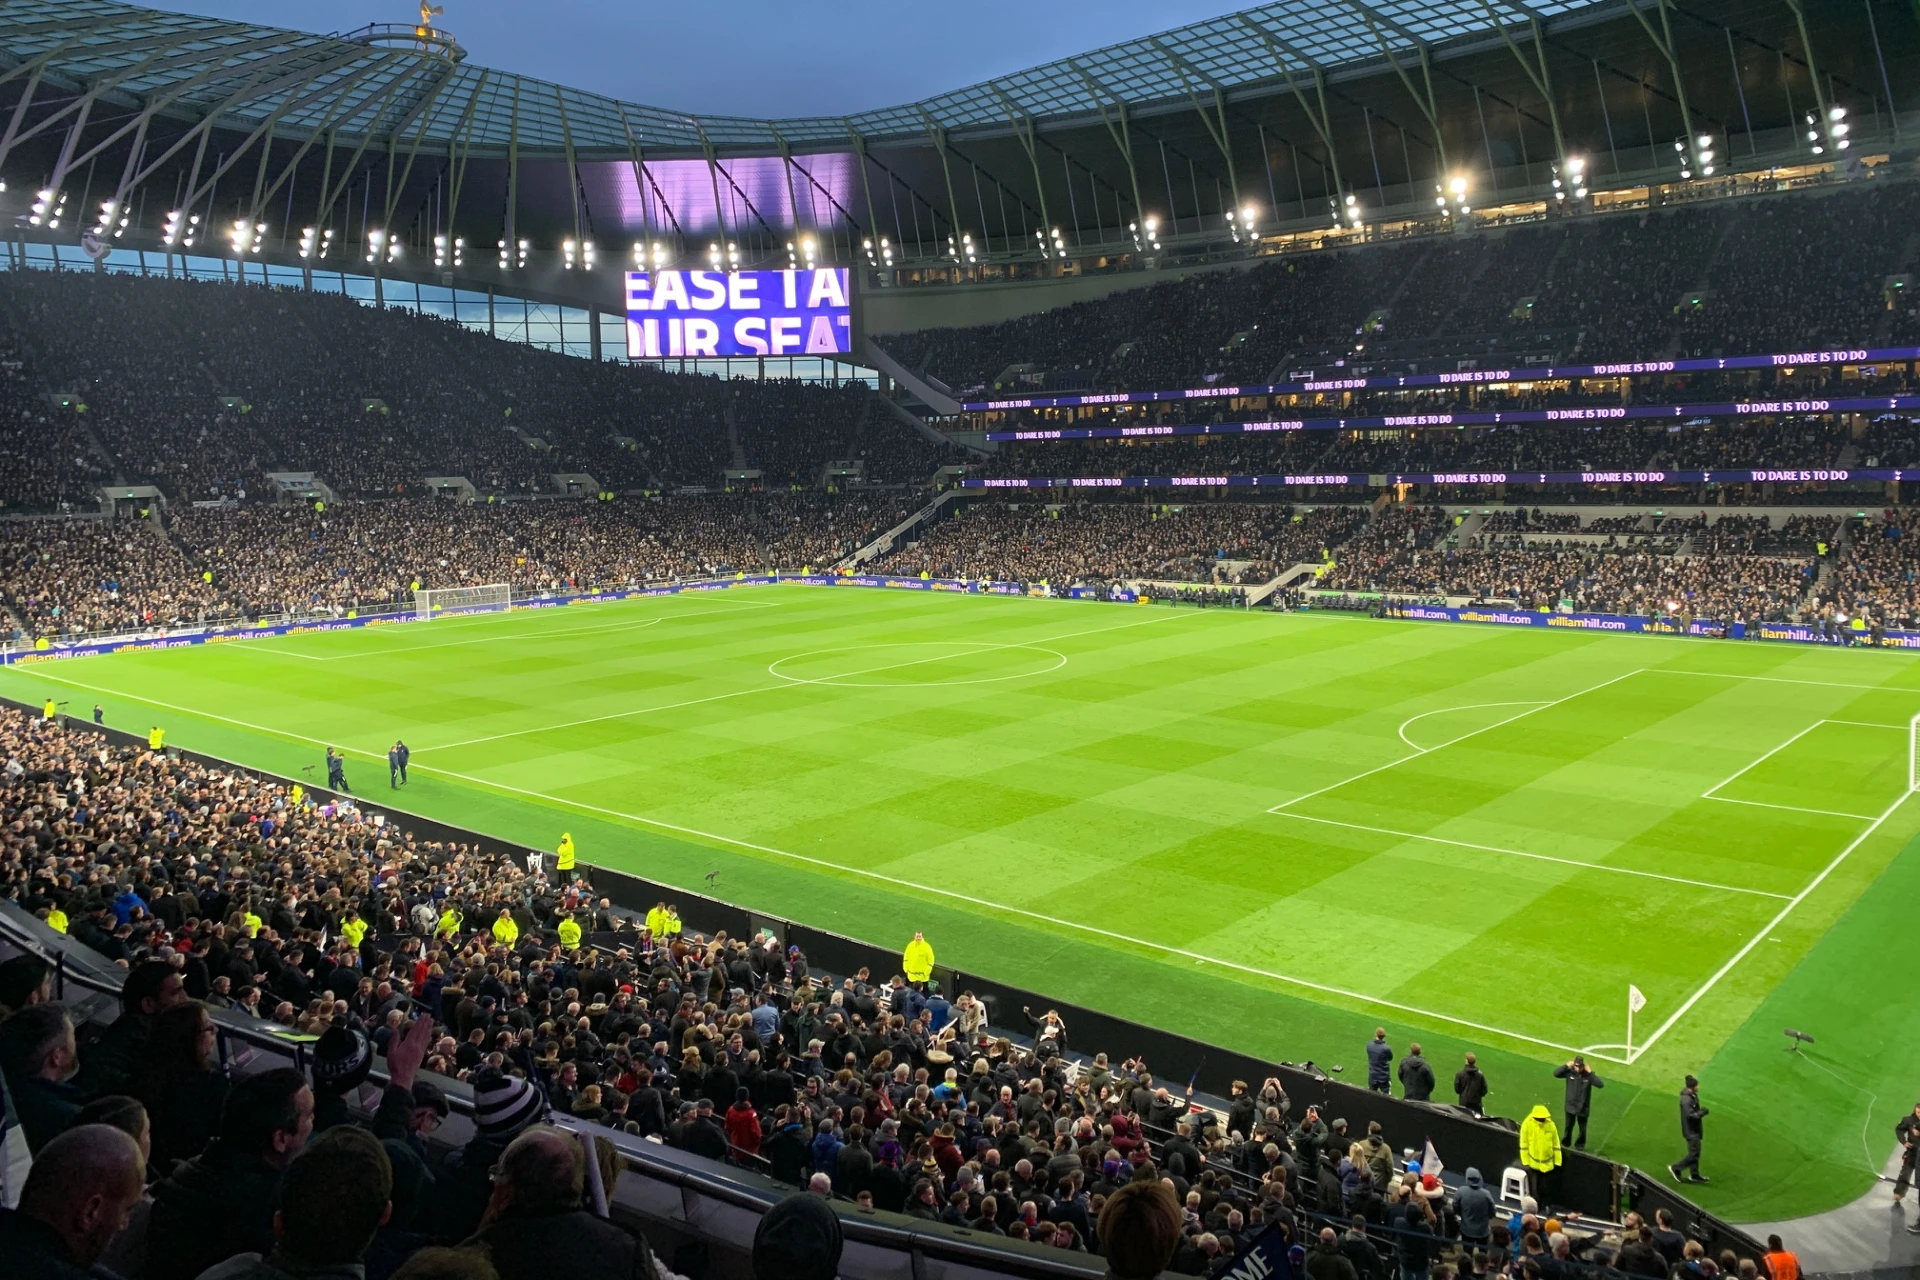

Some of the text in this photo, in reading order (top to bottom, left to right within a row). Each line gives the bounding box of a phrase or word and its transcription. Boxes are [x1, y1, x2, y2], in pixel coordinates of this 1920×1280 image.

[626, 268, 849, 310] EASE TA
[1773, 351, 1866, 364] TO DARE IS TO DO
[1594, 362, 1673, 374] TO DARE IS TO DO
[1439, 374, 1450, 382] TO
[1451, 373, 1472, 381] DARE
[1475, 372, 1482, 380] IS
[1497, 371, 1509, 379] DO
[1343, 380, 1353, 388] TO
[1354, 379, 1365, 387] DO
[1736, 401, 1828, 413] TO DARE IS TO DO
[1547, 409, 1624, 419] TO DARE IS TO DO
[1384, 415, 1452, 425] TO DARE IS TO DO
[1273, 422, 1279, 430] IS
[1291, 421, 1302, 429] DO
[1206, 477, 1215, 485] TO
[1217, 477, 1227, 485] DO
[1284, 476, 1294, 484] TO
[1296, 476, 1314, 484] DARE
[1316, 476, 1323, 484] IS
[1433, 474, 1505, 483] TO DARE IS TO DO
[1582, 473, 1664, 482] TO DARE IS TO DO
[1752, 471, 1847, 481] TO DARE IS TO DO
[1458, 612, 1531, 625] williamhill.com
[1547, 616, 1626, 630] williamhill.com
[1219, 1245, 1274, 1280] ME
